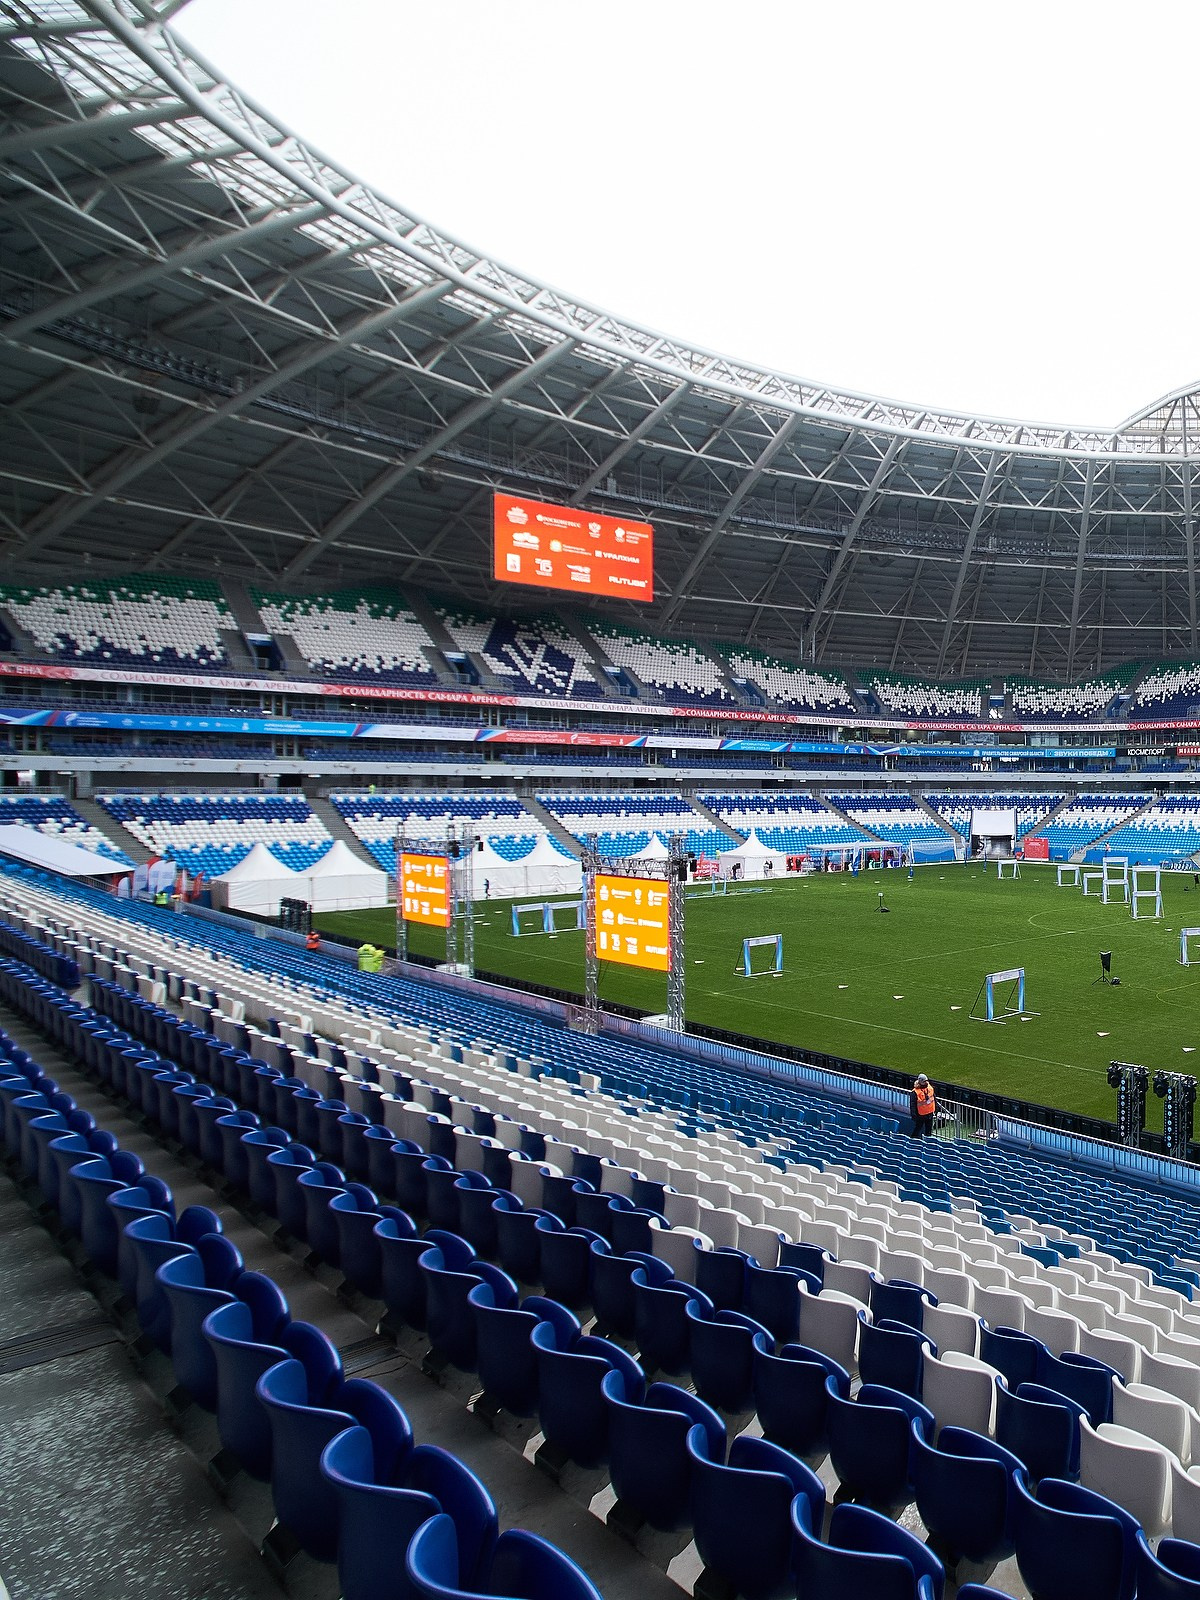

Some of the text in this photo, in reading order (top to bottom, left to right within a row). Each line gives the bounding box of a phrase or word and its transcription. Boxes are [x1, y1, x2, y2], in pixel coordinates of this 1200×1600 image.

[603, 552, 640, 563] УРАЛХИМ
[608, 576, 646, 588] RUTUBE
[99, 671, 205, 686] СОЛИДАРНОСТЬ
[262, 682, 298, 691] АРЕНА
[342, 687, 499, 704] СОЛИДАРНОСТЬ САМАРА АРЕНА
[534, 699, 600, 710] СОЛИДАРНОСТЬ
[601, 704, 634, 712] САМАРА
[685, 709, 739, 719] СОЛИДАРНОСТЬ
[739, 712, 766, 721] САМАРА
[917, 722, 966, 731] СОЛИДАРНОСТЬ
[1137, 722, 1176, 730] СОЛИДАРНОСТЬ
[1079, 750, 1109, 758] ПОБЕДЫ
